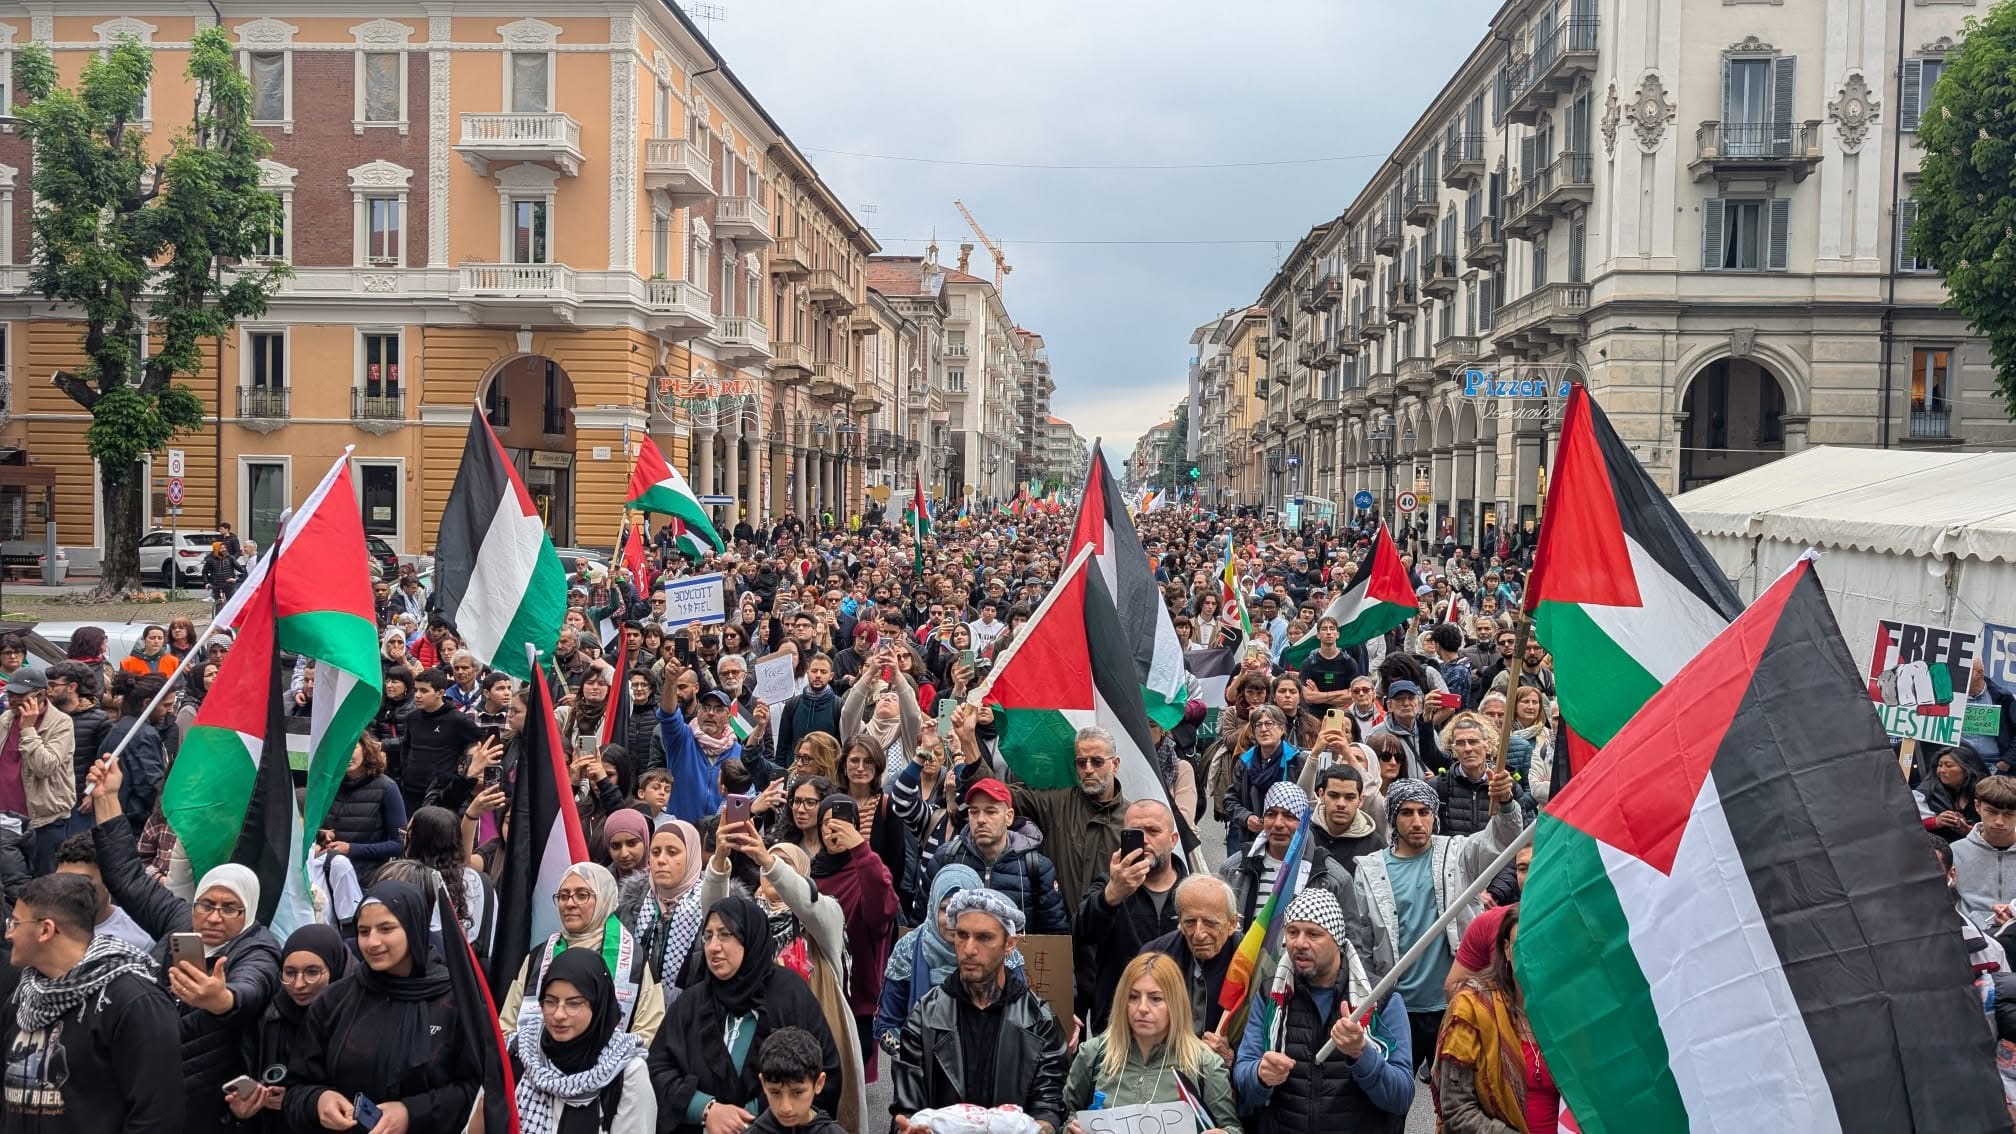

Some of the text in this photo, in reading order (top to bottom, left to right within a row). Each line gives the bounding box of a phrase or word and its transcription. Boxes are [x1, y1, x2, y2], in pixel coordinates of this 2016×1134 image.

[660, 378, 756, 398] PIZZERIA
[1402, 498, 1413, 506] 40
[1868, 619, 1976, 702] FREE
[1090, 1108, 1184, 1134] STOP
